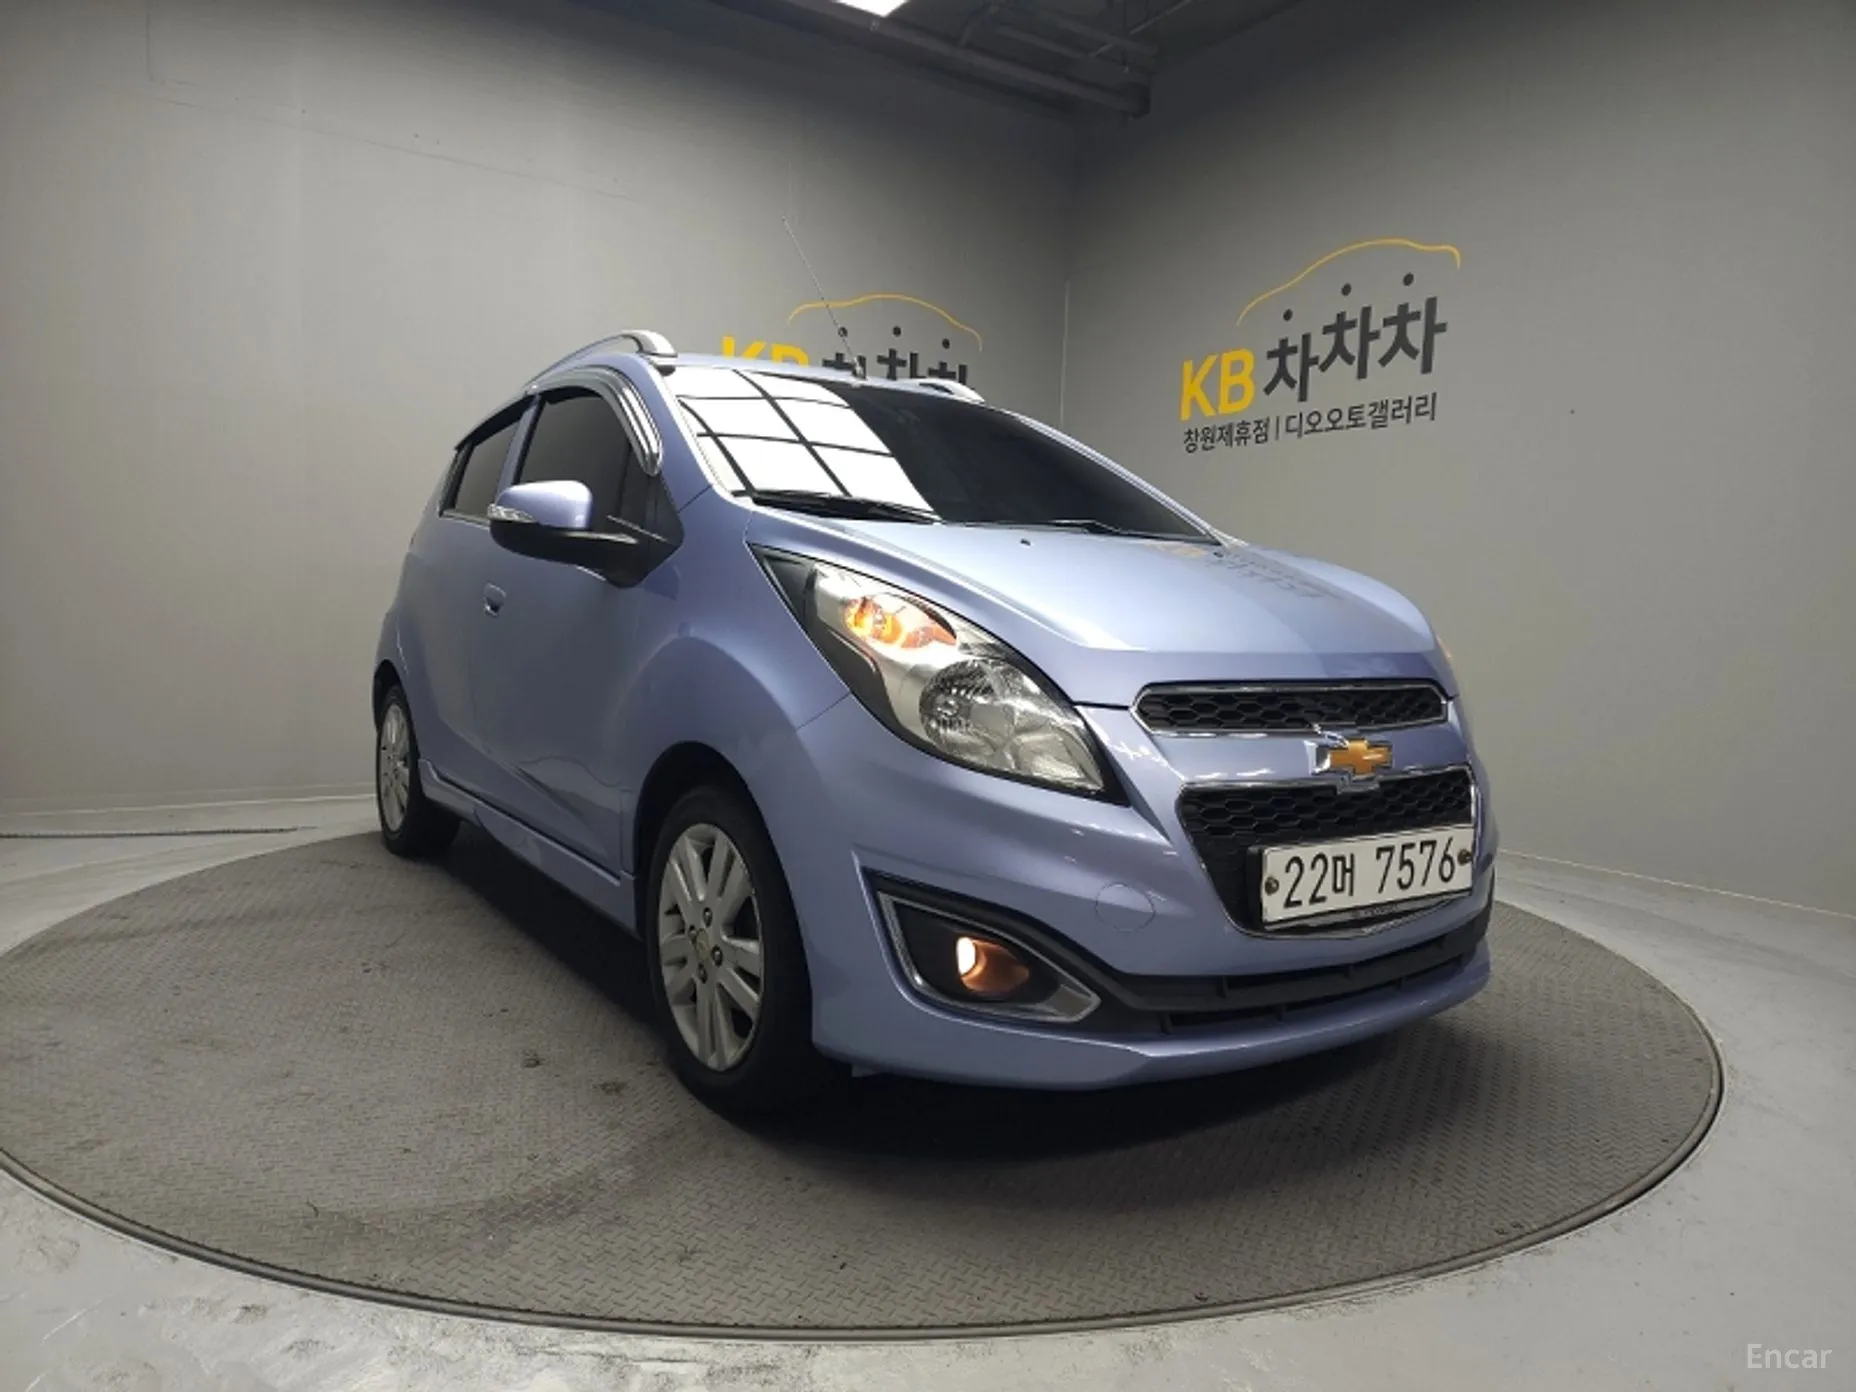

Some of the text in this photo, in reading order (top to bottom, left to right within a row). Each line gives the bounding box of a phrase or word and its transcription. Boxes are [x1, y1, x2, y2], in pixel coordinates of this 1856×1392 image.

[1180, 296, 1448, 421] KB 차차차
[1183, 416, 1270, 454] 창원제휴점
[1285, 392, 1438, 438] 디오오토갤러리
[1283, 836, 1456, 909] 22머 7576
